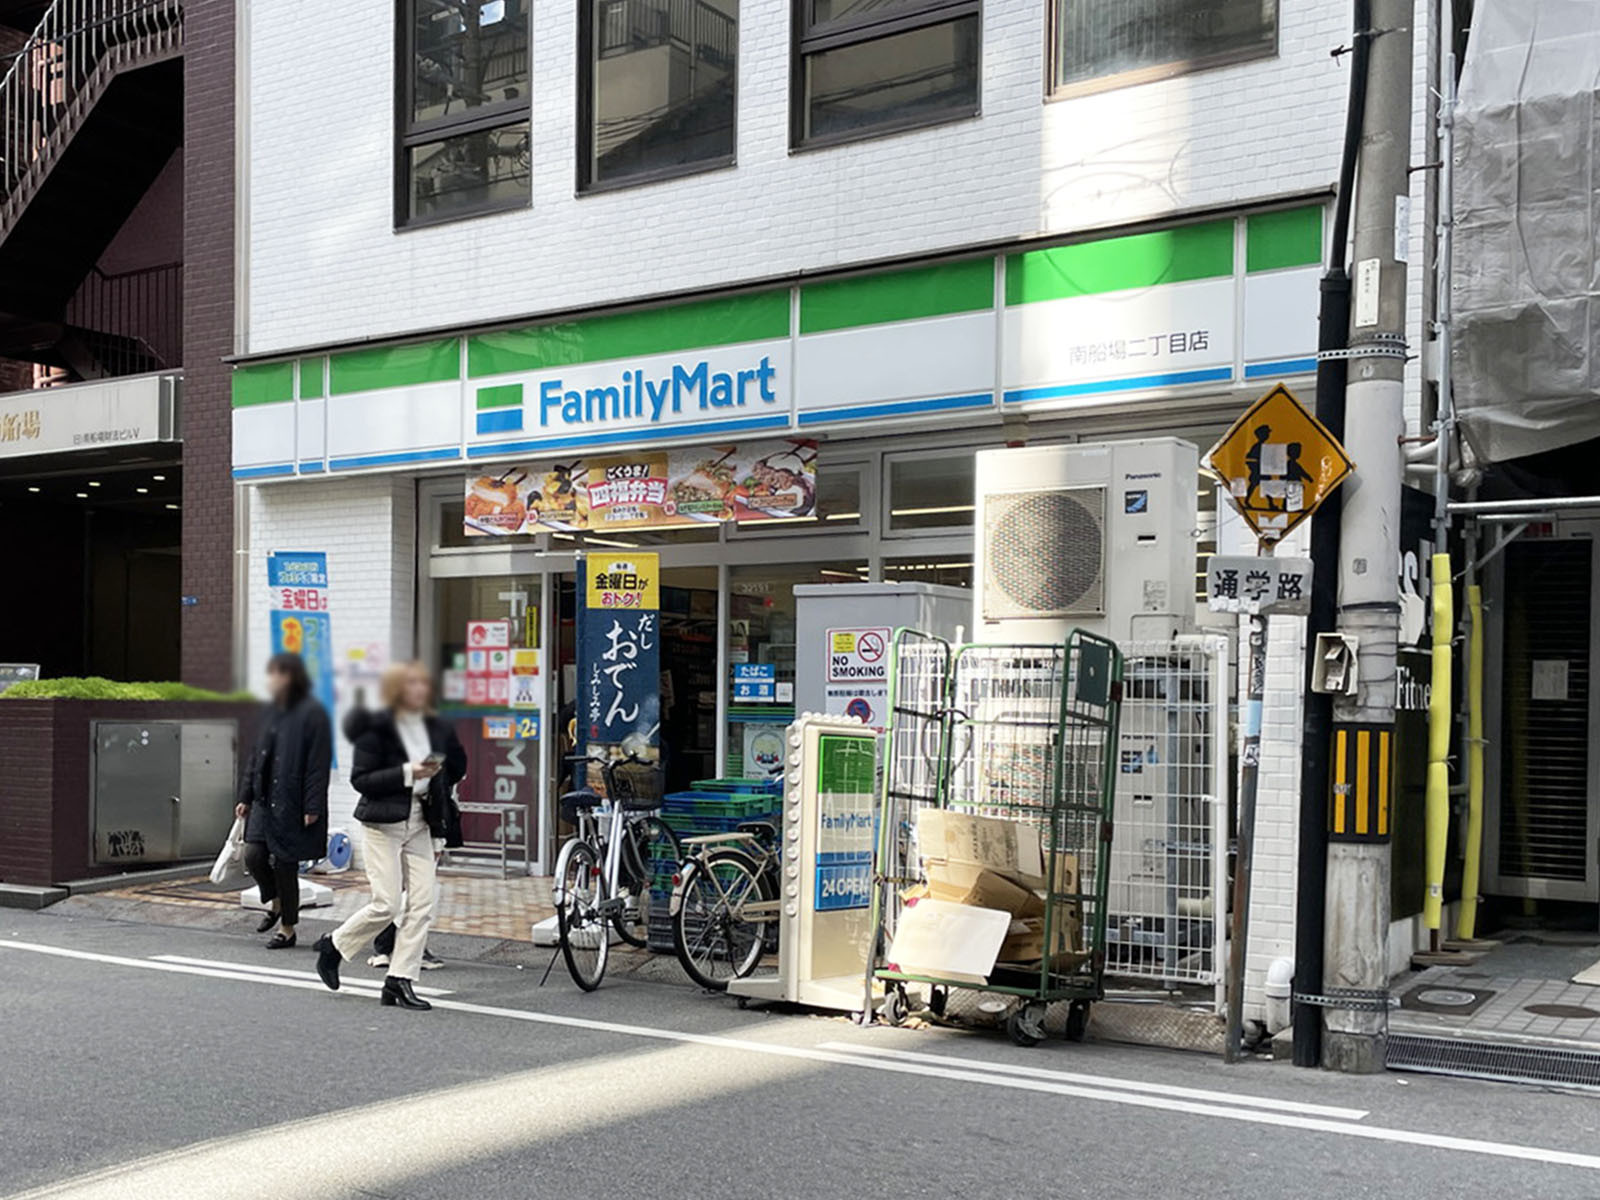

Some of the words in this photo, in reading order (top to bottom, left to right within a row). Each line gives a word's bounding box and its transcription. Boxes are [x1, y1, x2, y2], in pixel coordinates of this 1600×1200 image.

[1069, 330, 1209, 366] 南船場二丁目店
[540, 356, 776, 427] FamilyMart
[0, 410, 41, 442] 船場
[1125, 472, 1161, 480] Panasonic
[595, 573, 649, 590] 金曜日が
[1214, 569, 1303, 600] 通学路
[281, 588, 327, 610] 金曜日は
[602, 592, 642, 607] おトク!
[638, 614, 655, 650] だし
[740, 666, 769, 677] たばこ
[832, 655, 849, 666] NO
[602, 619, 639, 727] おでん
[832, 666, 885, 678] SMOKING
[1396, 666, 1432, 709] Fitne
[821, 812, 872, 832] FamilyMart
